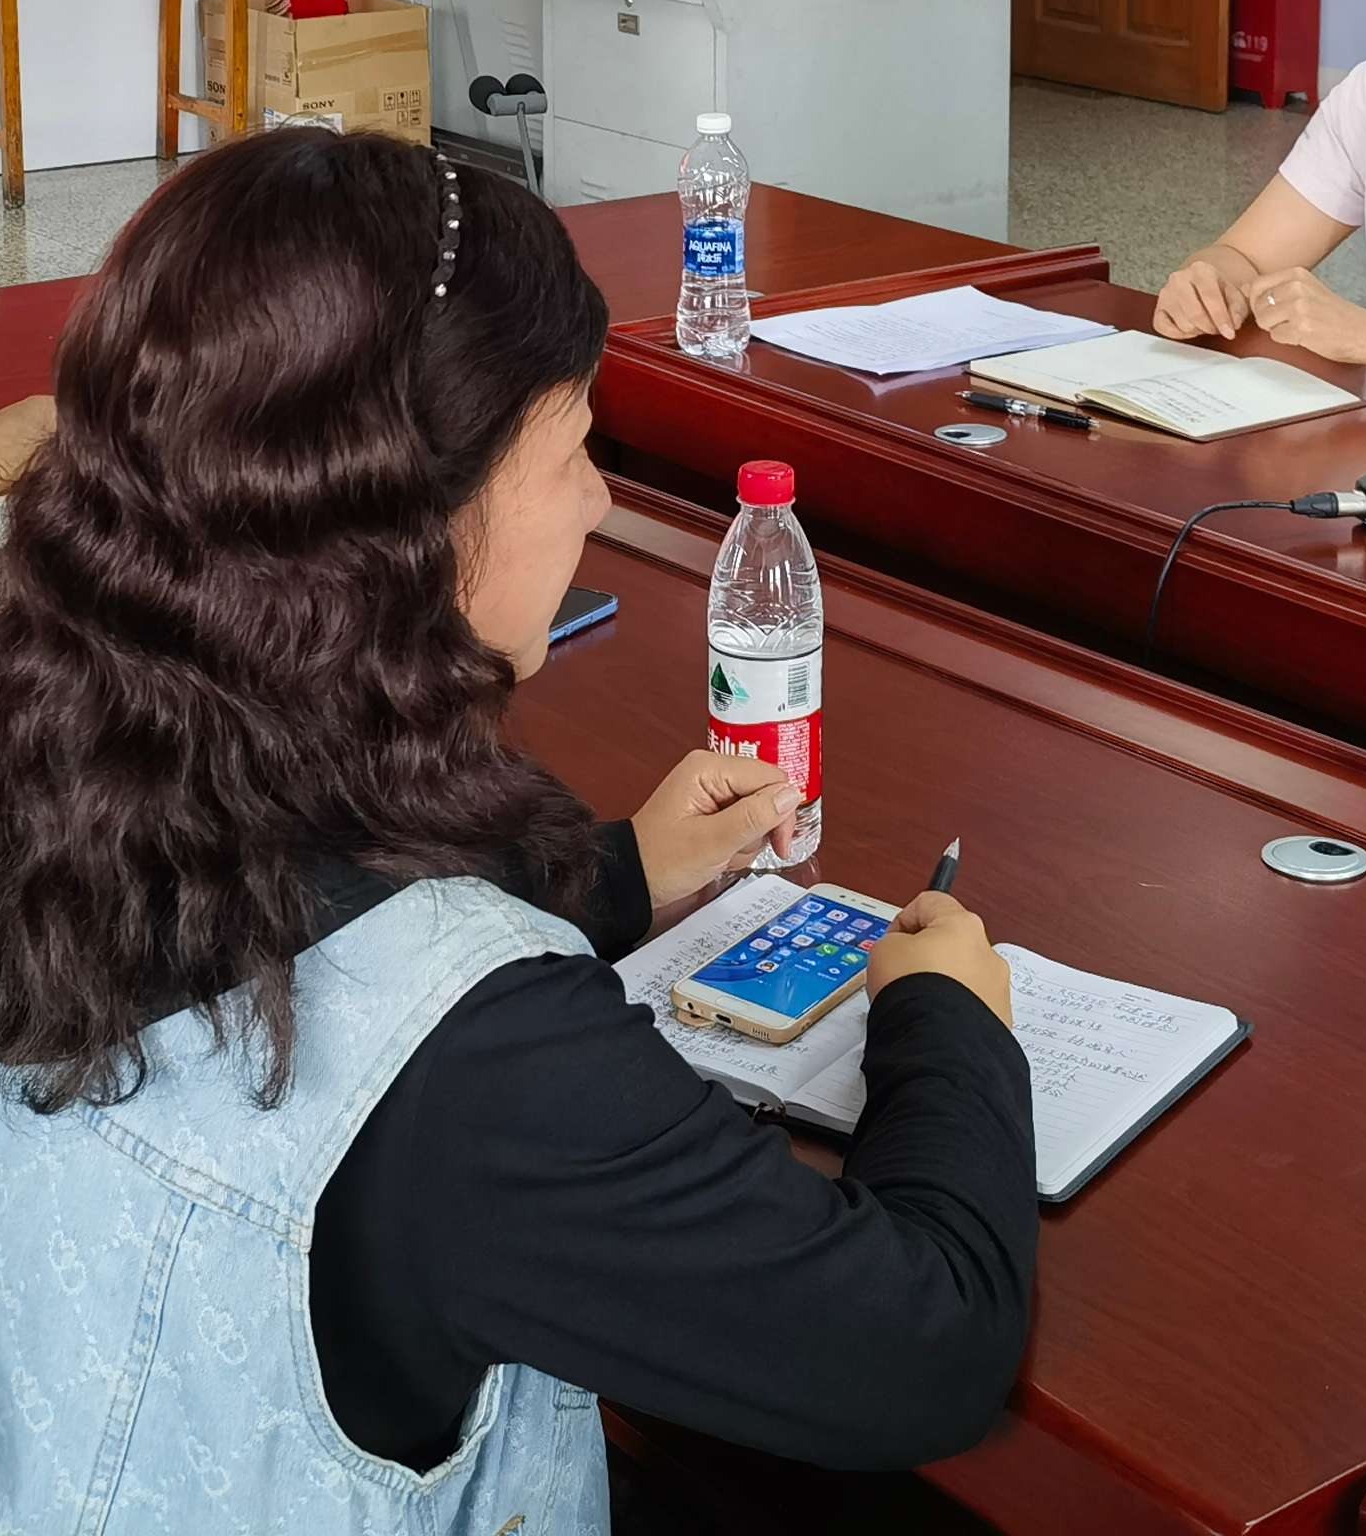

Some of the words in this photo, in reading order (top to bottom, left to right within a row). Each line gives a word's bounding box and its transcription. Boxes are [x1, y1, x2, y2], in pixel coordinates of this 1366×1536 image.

[207, 81, 227, 95] SON
[302, 99, 336, 111] SONY
[707, 727, 761, 759] 夫山泉
